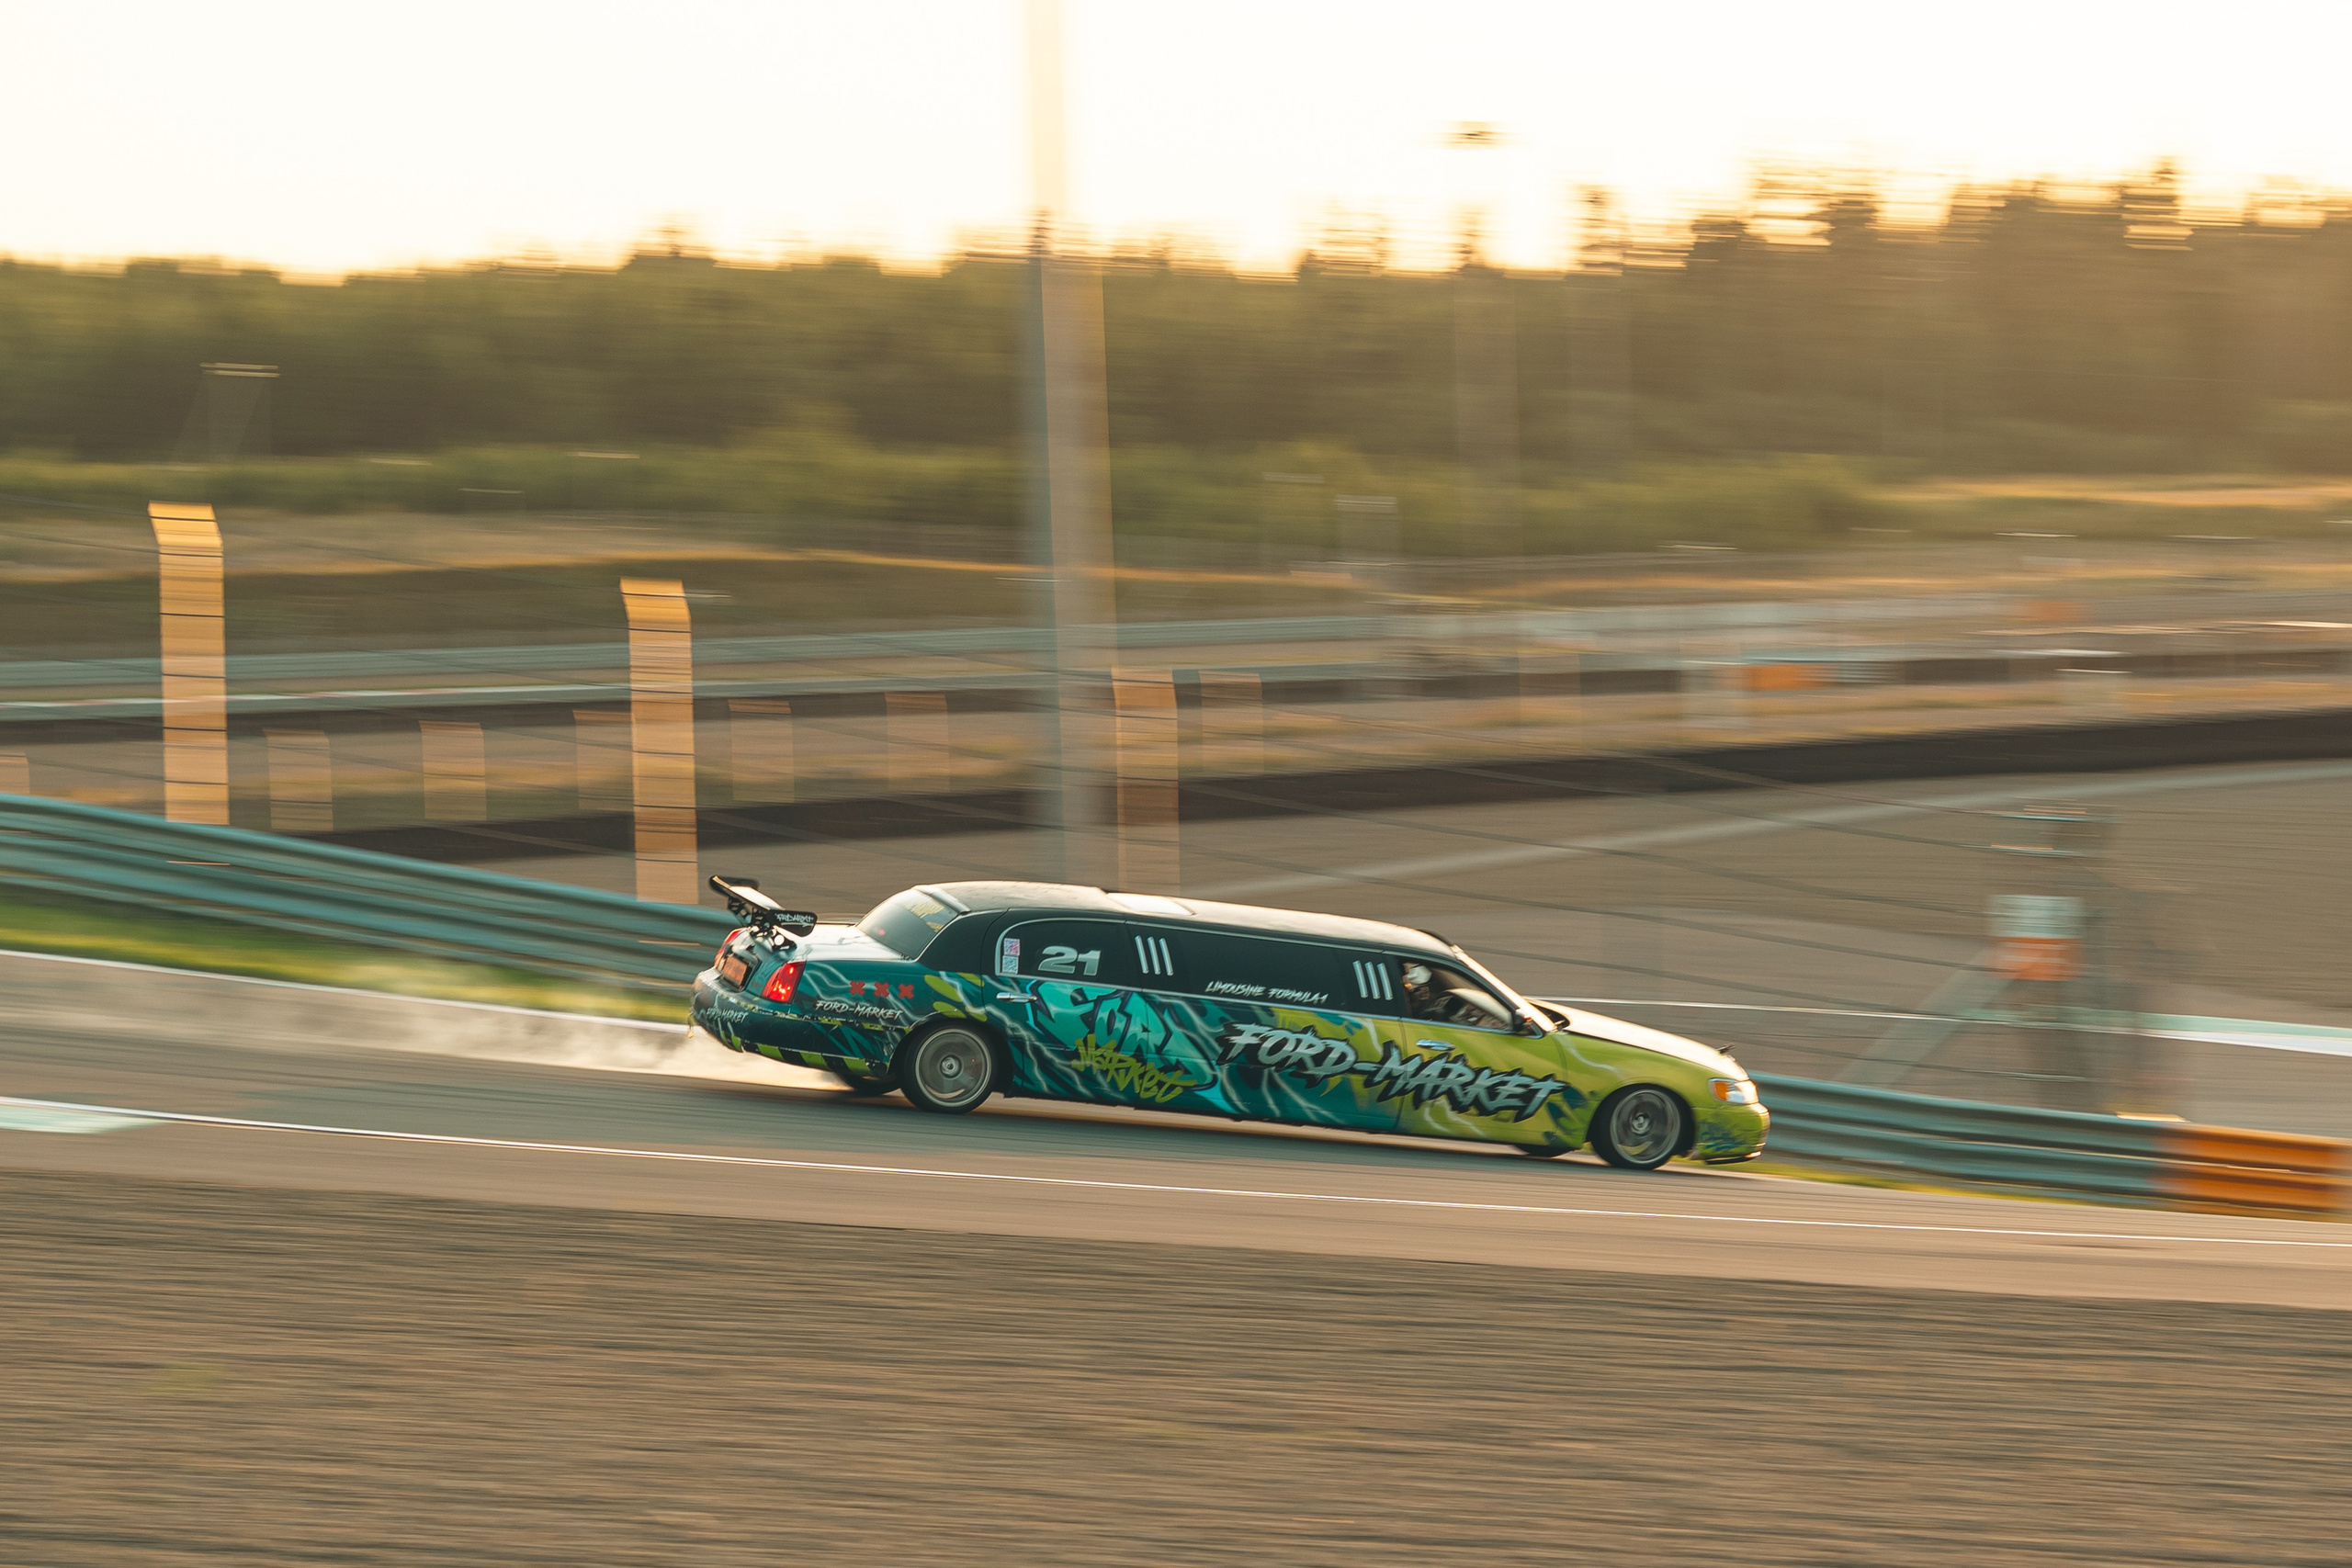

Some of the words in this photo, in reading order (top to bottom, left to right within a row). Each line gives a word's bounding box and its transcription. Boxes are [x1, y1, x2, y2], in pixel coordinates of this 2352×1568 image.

[1037, 945, 1101, 976] 21
[1204, 980, 1266, 998] LIMOUSINE
[815, 1000, 903, 1021] FORD-MARKET
[1221, 1022, 1566, 1119] FORD-MARKET
